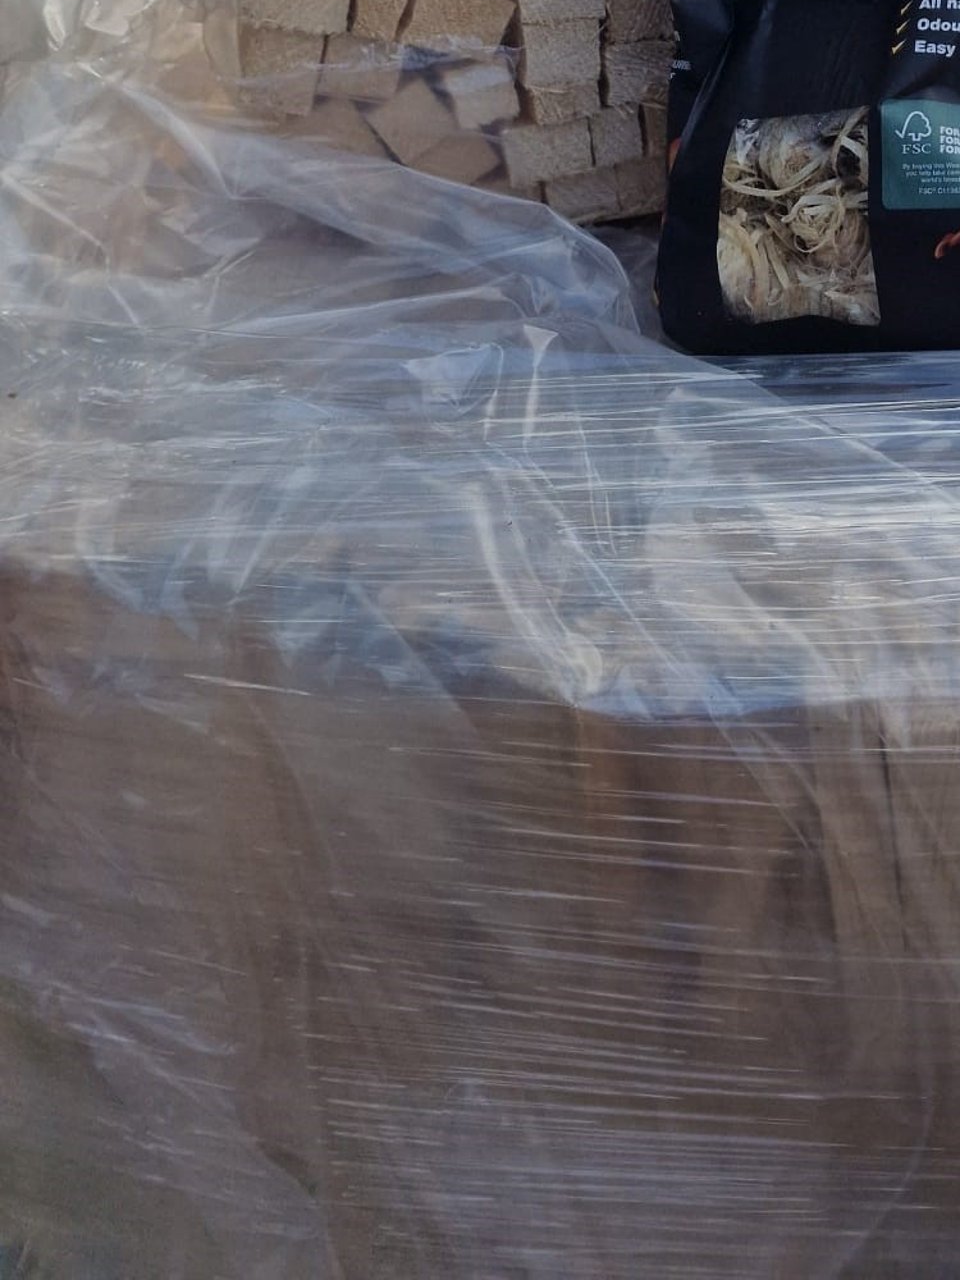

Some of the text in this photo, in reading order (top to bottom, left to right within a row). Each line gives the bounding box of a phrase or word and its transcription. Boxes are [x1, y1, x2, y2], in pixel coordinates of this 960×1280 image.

[914, 39, 956, 58] Easy
[939, 135, 960, 146] FOR
[901, 143, 932, 155] FSC
